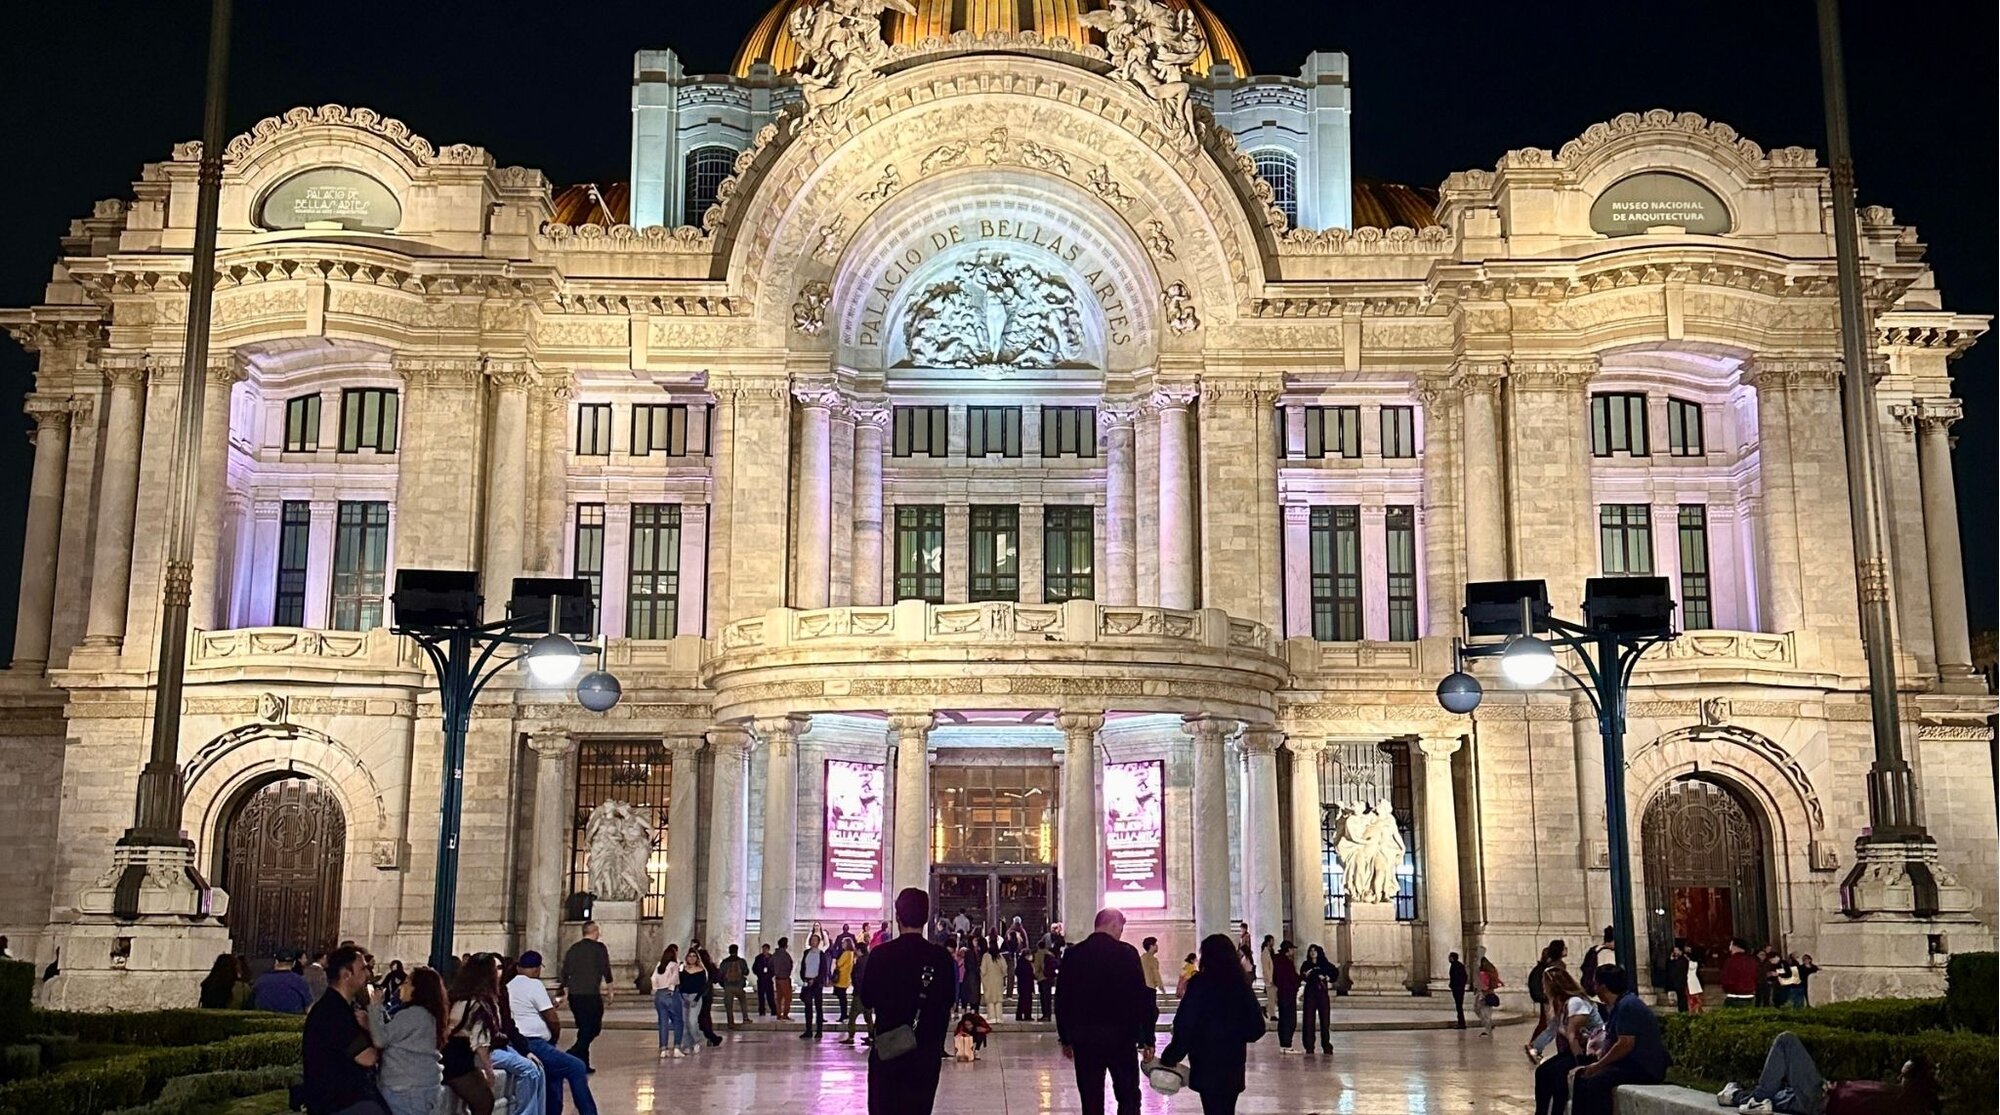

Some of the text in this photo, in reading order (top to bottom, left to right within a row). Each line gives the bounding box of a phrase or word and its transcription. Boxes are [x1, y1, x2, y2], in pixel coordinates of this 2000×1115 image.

[306, 190, 345, 199] PALACIO
[294, 199, 370, 210] BELLAS ARTES
[1612, 201, 1704, 210] MUSEO NACIONAL
[1612, 212, 1704, 221] DE ARQUITECTURA
[860, 219, 1131, 347] PALACIO DE BELLAS ARTES
